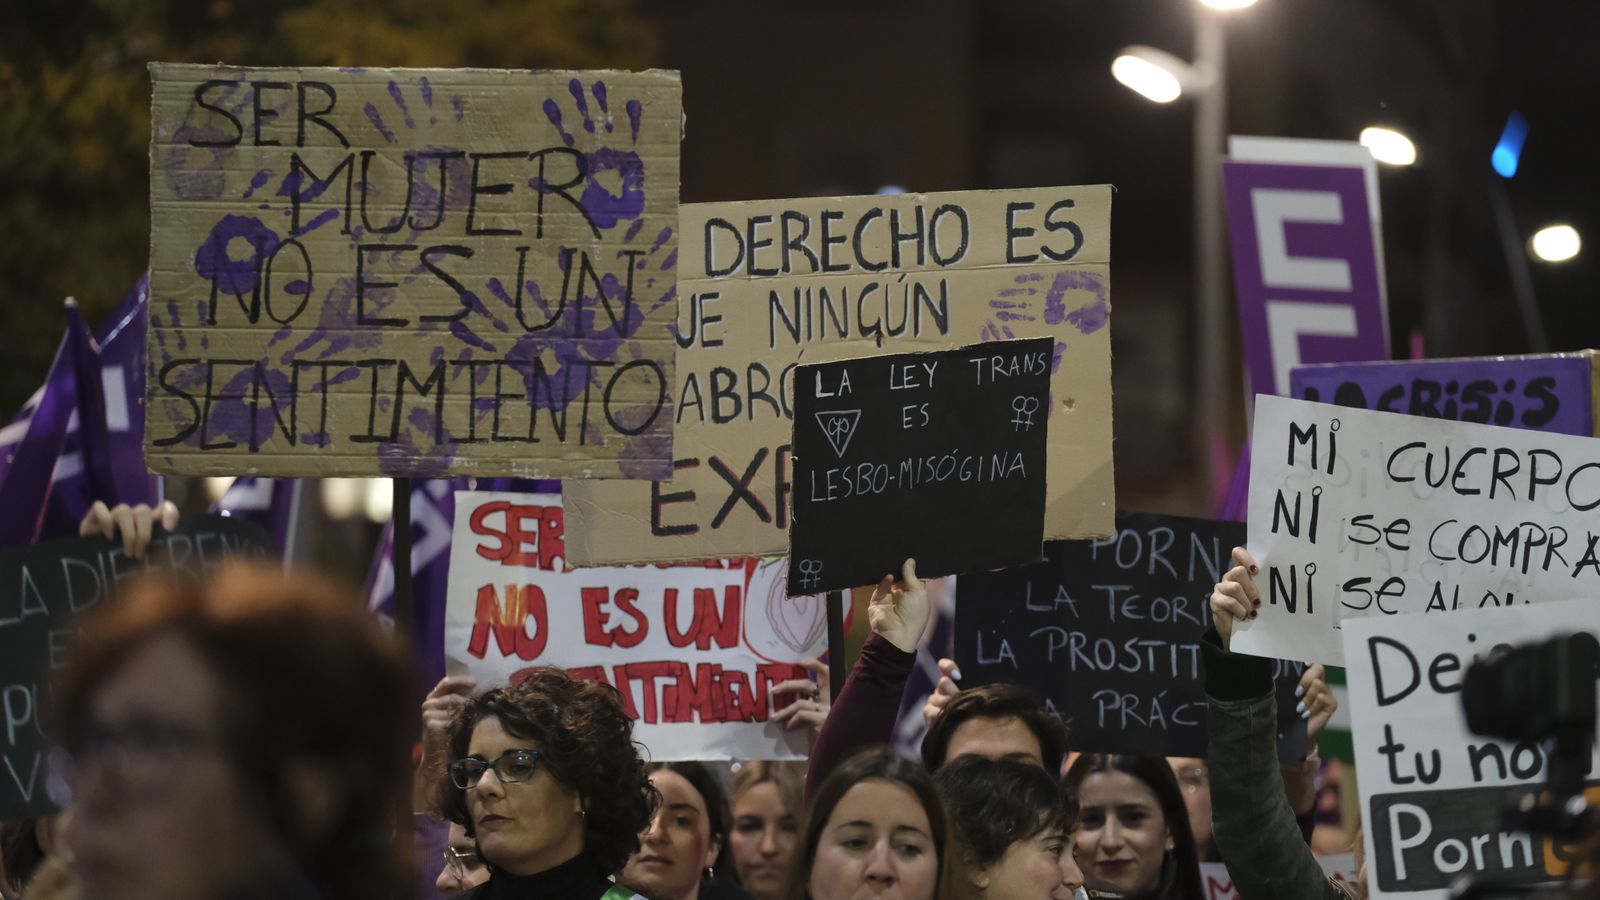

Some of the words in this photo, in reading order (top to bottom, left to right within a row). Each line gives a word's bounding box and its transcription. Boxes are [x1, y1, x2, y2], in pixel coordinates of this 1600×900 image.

[189, 79, 351, 148] SER
[289, 146, 602, 239] MUJER
[704, 204, 969, 277] DERECHO
[1006, 199, 1084, 263] ES
[207, 236, 313, 326] NO
[356, 243, 475, 328] ES
[514, 246, 646, 338] UN
[676, 291, 724, 349] UE
[769, 273, 949, 349] NINGÚN
[153, 357, 667, 452] SENTIMIENTO
[815, 368, 852, 399] LA
[889, 361, 938, 391] LEY
[969, 352, 1047, 386] TRANS
[903, 403, 930, 430] ES
[811, 448, 1027, 502] LESBO-MISÓGINA
[470, 500, 575, 574] SER
[467, 583, 549, 661] NO
[580, 586, 649, 649] ES
[663, 584, 741, 651] UN
[1025, 581, 1079, 618] LA
[976, 631, 1018, 669] LA
[1377, 723, 1442, 785] tu
